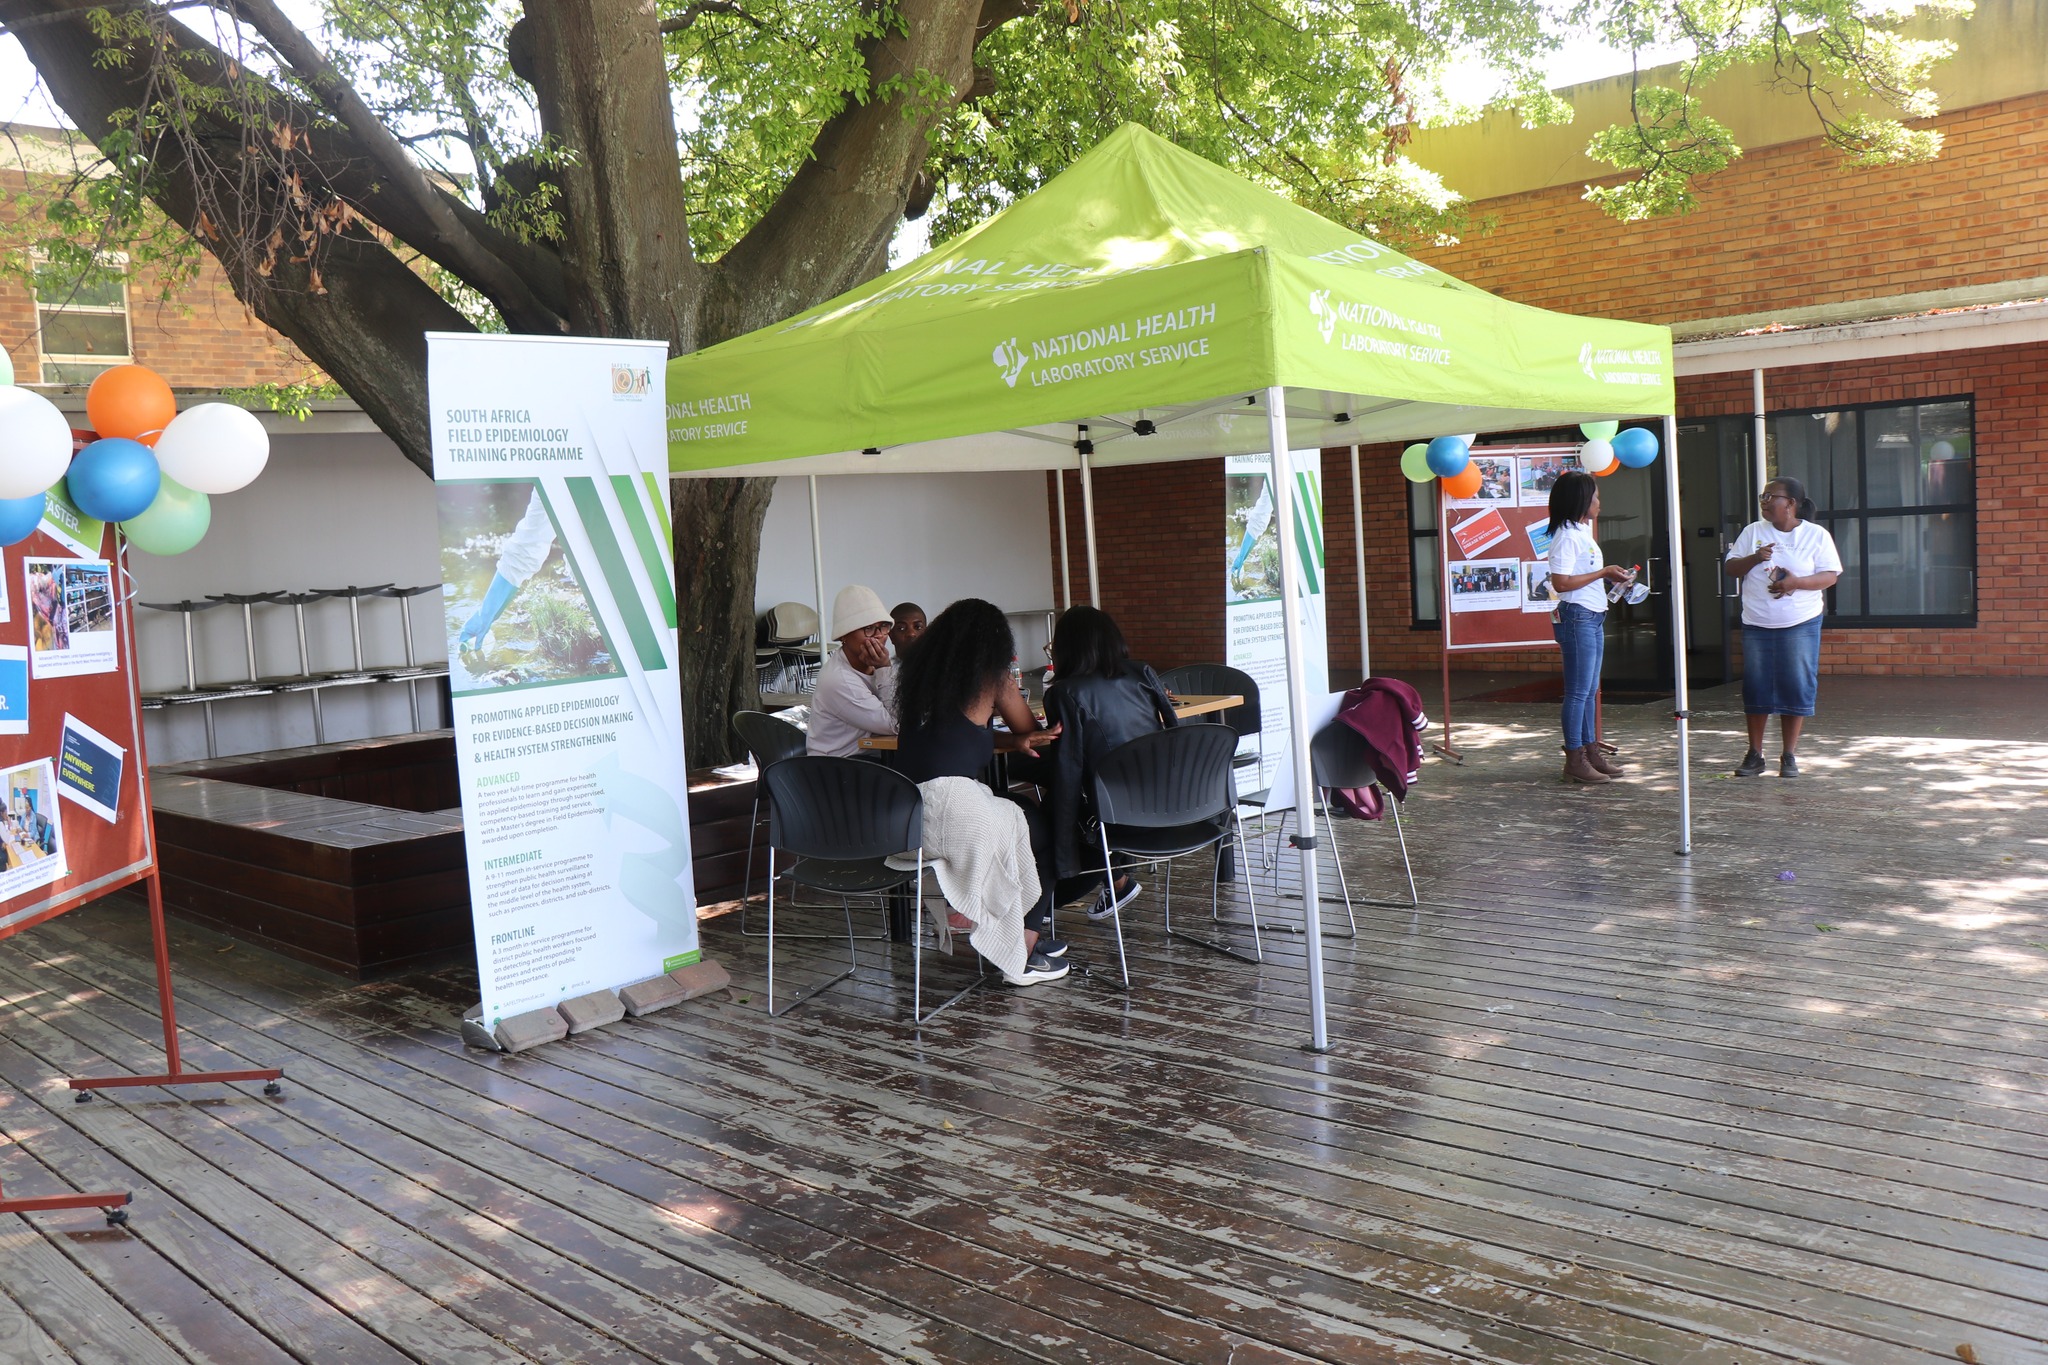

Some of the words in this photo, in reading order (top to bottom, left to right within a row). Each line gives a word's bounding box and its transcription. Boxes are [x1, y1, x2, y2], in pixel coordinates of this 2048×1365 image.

[1338, 302, 1408, 331] NATIONAL
[1032, 322, 1131, 360] NATIONAL
[1136, 303, 1216, 338] HEALTH
[1342, 333, 1407, 359] LABORATORY
[1410, 345, 1450, 365] SERVICE
[1594, 349, 1634, 364] NATIONAL
[1633, 350, 1662, 364] HEALTH
[1031, 352, 1135, 386] LABORATORY
[1140, 338, 1209, 366] SERVICE
[1640, 373, 1663, 385] SERVICE
[699, 393, 751, 415] HEALTH
[447, 409, 486, 423] SOUTH
[491, 410, 530, 423] AFRICA
[448, 429, 482, 442] FIELD
[486, 429, 568, 442] EPIDEMIOLOGY
[704, 421, 748, 438] SERVICE
[449, 448, 507, 462] TRAINING
[510, 447, 583, 461] PROGRAMME
[1232, 455, 1253, 463] TRAINING
[45, 495, 81, 534] ASTER.
[1233, 614, 1255, 622] PROMOTING
[1256, 611, 1272, 619] APPLIED
[1241, 623, 1272, 633] EVIDENCE-BASED
[1237, 637, 1250, 645] HEALTH
[1252, 635, 1266, 643] SYSTEM
[1233, 653, 1252, 661] ADVANCED
[471, 708, 523, 724] PROMOTING
[525, 703, 559, 717] APPLIED
[561, 695, 620, 712] EPIDEMIOLOGY
[473, 732, 490, 744] FOR
[493, 722, 562, 741] EVIDENCE-BASED
[564, 716, 600, 730] DECISION
[602, 711, 633, 725] MAKING
[474, 753, 481, 763] &
[484, 748, 515, 761] HEALTH
[518, 742, 549, 756] SYSTEM
[551, 732, 616, 751] STRENGTHENING
[63, 751, 94, 775] ANYWHERE
[477, 772, 520, 788] ADVANCED
[496, 789, 509, 797] year
[510, 783, 534, 793] full-time
[535, 779, 568, 790] programme
[578, 772, 596, 781] health
[478, 795, 517, 808] professionals
[541, 788, 552, 796] and
[553, 786, 566, 796] gain
[567, 783, 597, 793] experience
[487, 806, 509, 817] applied
[510, 800, 549, 813] epidemiology
[550, 794, 573, 804] through
[574, 789, 605, 801] supervised,
[480, 810, 536, 826] competency-based
[537, 807, 559, 816] training
[560, 803, 570, 811] and
[571, 801, 592, 809] service,
[481, 826, 495, 835] with
[501, 821, 524, 831] Master's
[525, 819, 545, 827] degree
[553, 813, 567, 821] Field
[568, 807, 605, 820] Epidemiology
[481, 834, 508, 844] awarded
[509, 832, 524, 840] upon
[525, 825, 559, 836] completion.
[484, 850, 543, 870] INTERMEDIATE
[491, 871, 504, 879] 9-11
[505, 867, 524, 876] month
[525, 862, 553, 872] in-service
[554, 856, 586, 868] programme
[486, 879, 518, 890] strengthen
[519, 874, 537, 885] public
[538, 869, 556, 879] health
[557, 864, 590, 875] surveillance
[487, 891, 498, 899] and
[541, 877, 564, 887] decision
[566, 873, 586, 882] making
[489, 908, 503, 917] such
[511, 902, 540, 914] provinces,
[541, 896, 564, 905] districts,
[566, 891, 576, 899] and
[577, 885, 611, 897] sub-districts.
[499, 896, 519, 906] middle
[520, 892, 534, 901] level
[535, 890, 541, 898] of
[552, 884, 570, 894] health
[571, 882, 591, 891] system,
[491, 926, 535, 945] FRONTLINE
[503, 942, 522, 952] month
[523, 936, 550, 947] in-service
[551, 929, 583, 942] programme
[493, 955, 513, 965] district
[514, 950, 532, 961] public
[533, 944, 551, 954] health
[552, 940, 574, 949] workers
[575, 933, 597, 944] focused
[503, 960, 530, 971] detecting
[531, 955, 542, 964] and
[543, 949, 575, 961] responding
[495, 972, 519, 982] diseases
[520, 967, 531, 976] and
[532, 964, 551, 973] events
[558, 956, 576, 967] public
[495, 981, 514, 991] health
